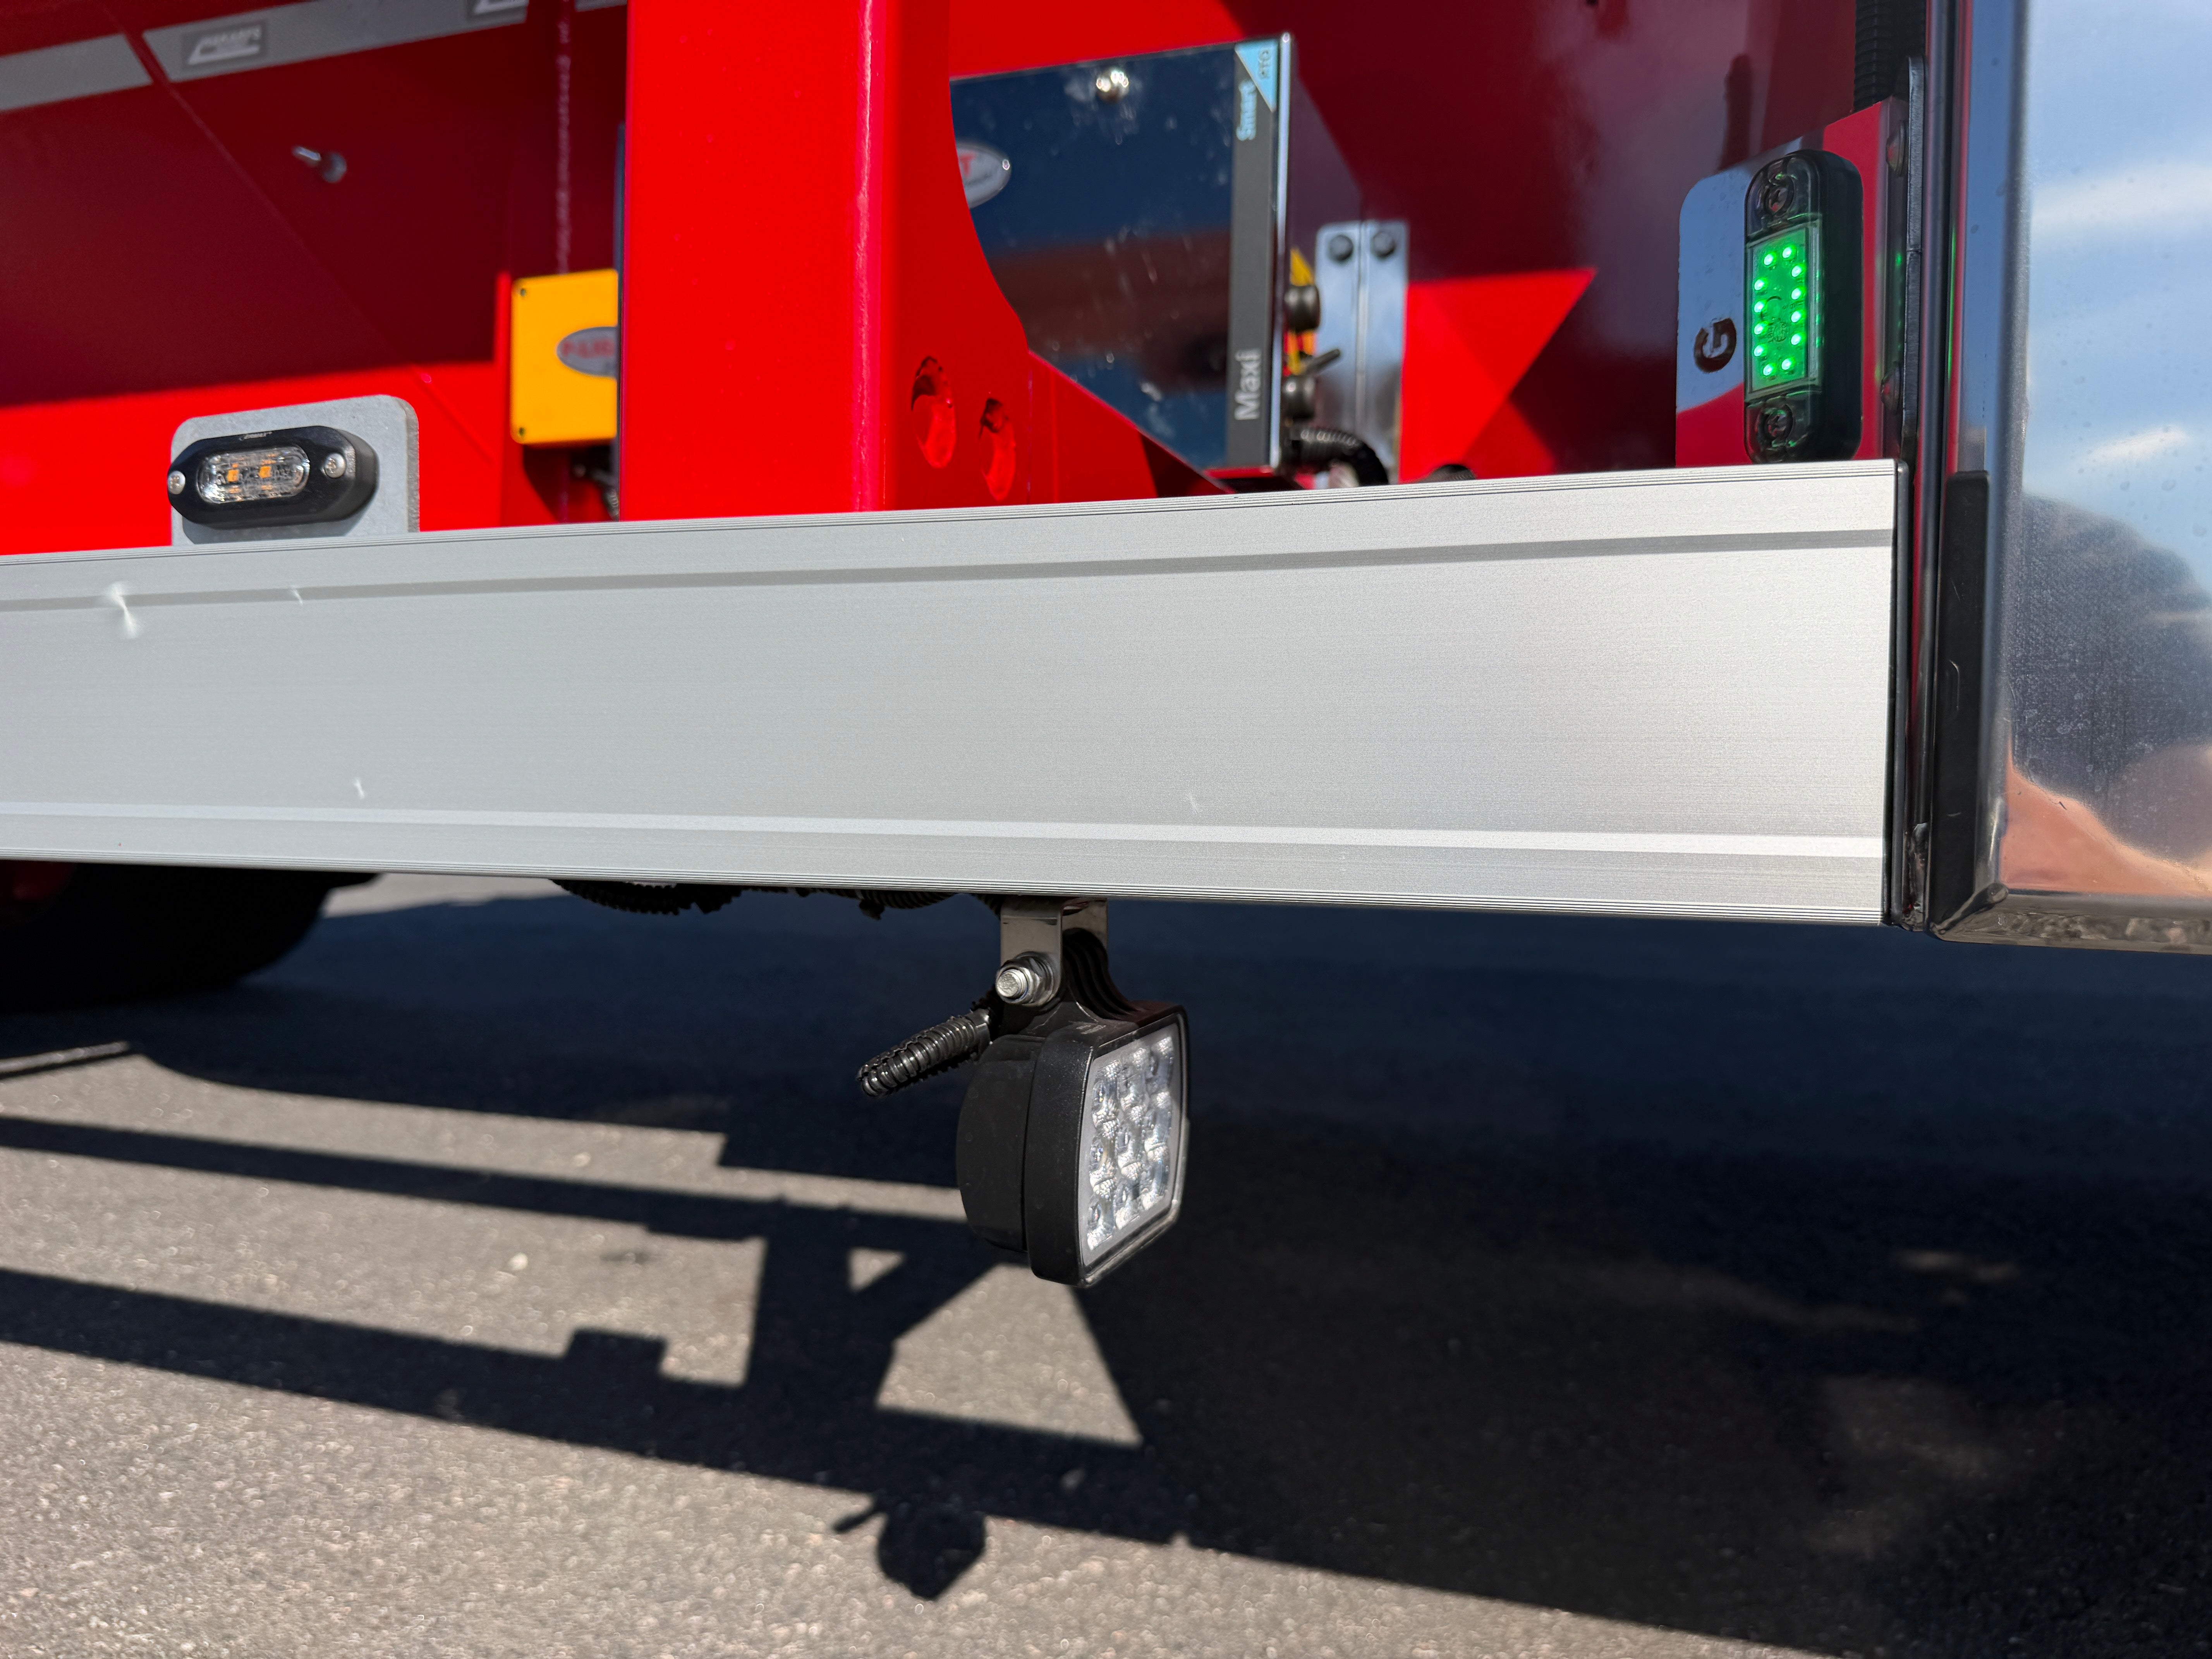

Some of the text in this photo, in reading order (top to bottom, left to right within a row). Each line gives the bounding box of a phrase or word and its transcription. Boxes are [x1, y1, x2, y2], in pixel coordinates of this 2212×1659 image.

[1236, 81, 1257, 141] Smart
[1694, 318, 1737, 374] G
[1235, 350, 1261, 421] Maxi
